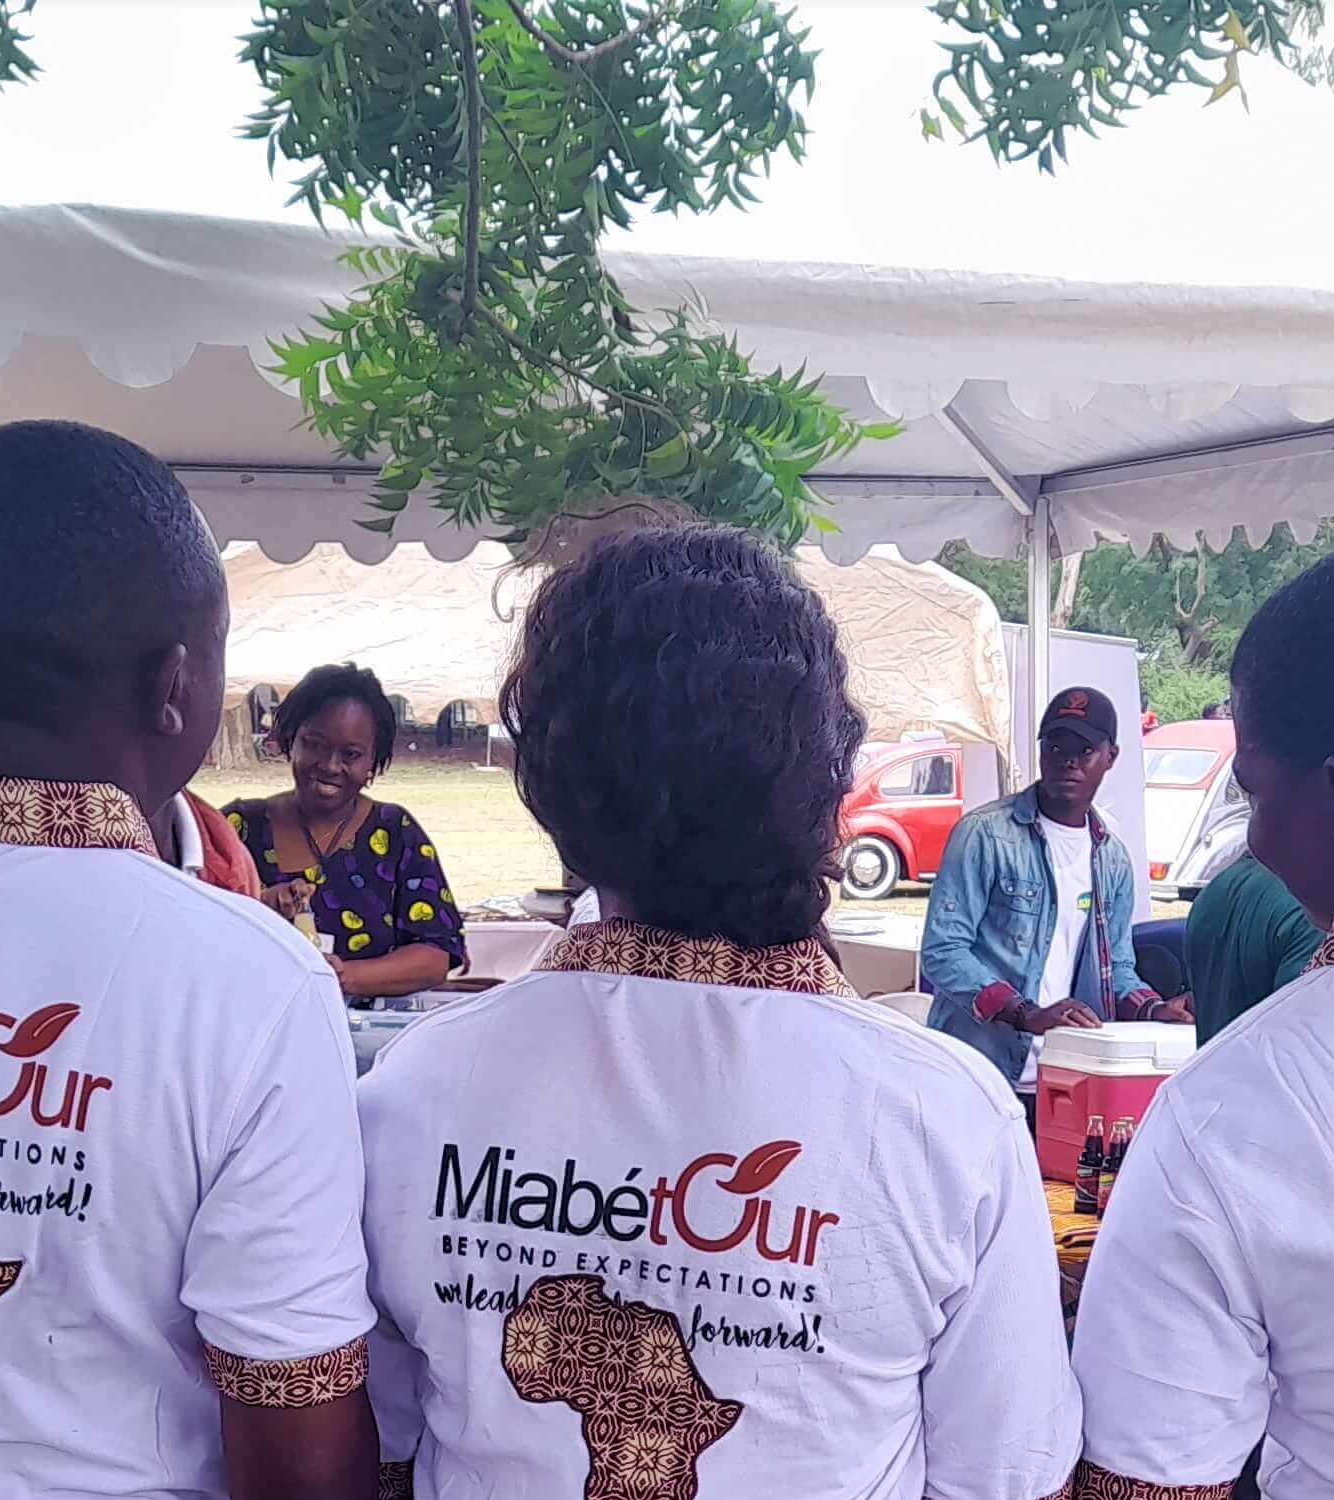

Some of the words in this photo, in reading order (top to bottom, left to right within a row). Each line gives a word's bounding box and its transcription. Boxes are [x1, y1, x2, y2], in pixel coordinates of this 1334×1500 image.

[442, 1235, 557, 1268] BEYOND
[576, 1253, 816, 1303] EXPECTATIONS
[685, 1304, 825, 1354] forward!
